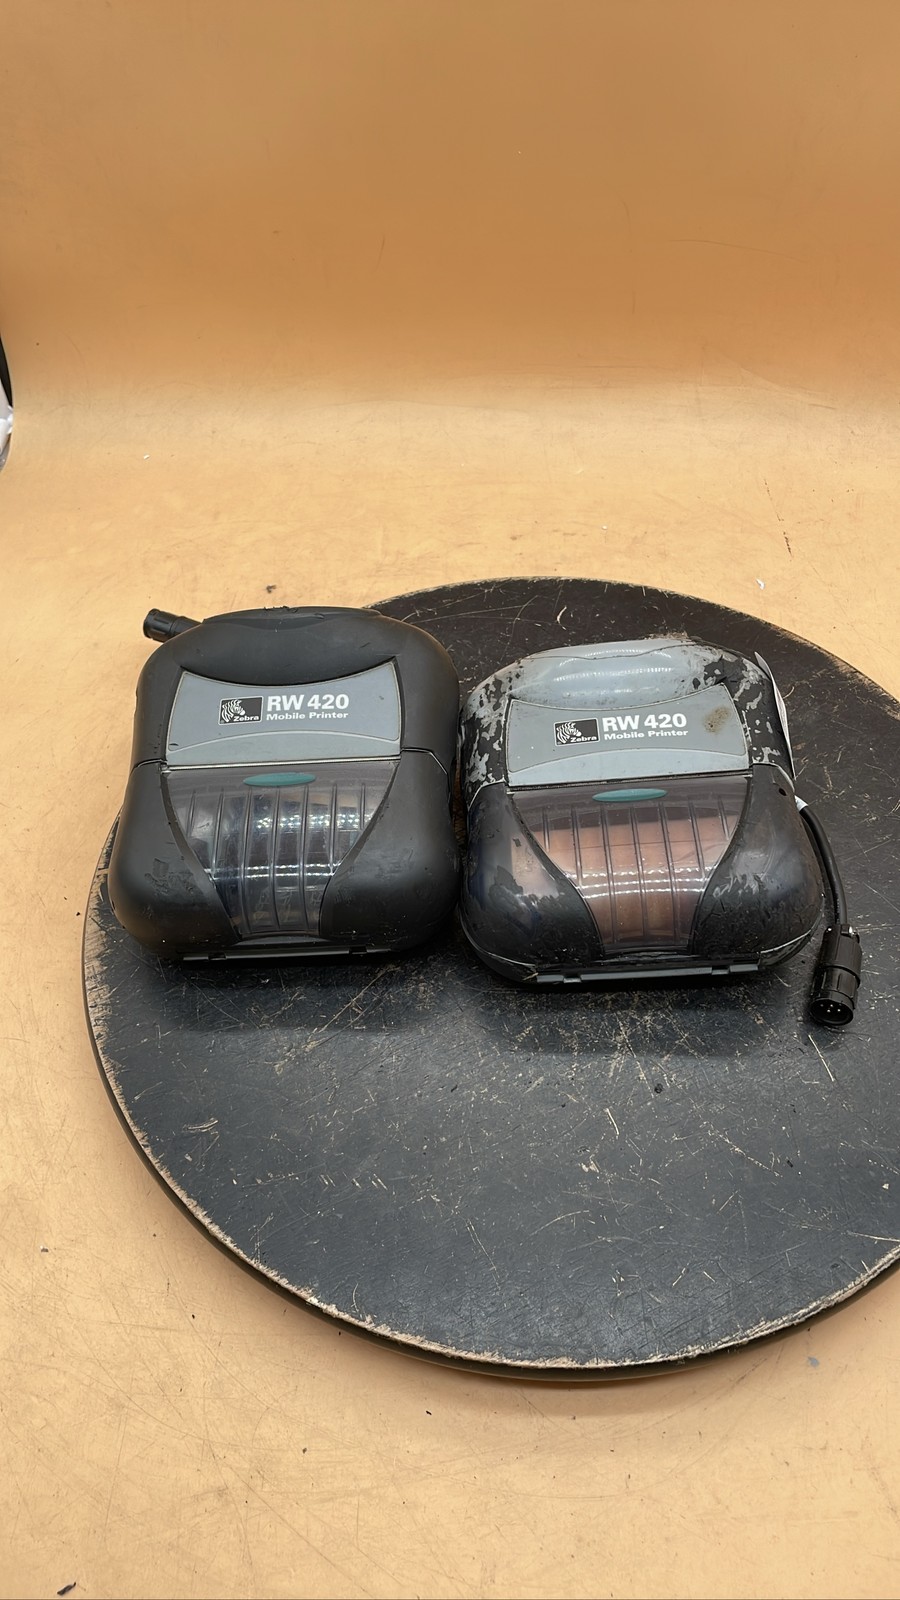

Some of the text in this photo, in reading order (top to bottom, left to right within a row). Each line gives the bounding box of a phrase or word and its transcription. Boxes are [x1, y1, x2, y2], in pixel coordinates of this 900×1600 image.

[267, 694, 349, 711] RW 420
[266, 711, 349, 720] Mobile Printer
[602, 713, 687, 732] RW 420
[604, 732, 645, 740] Mobile
